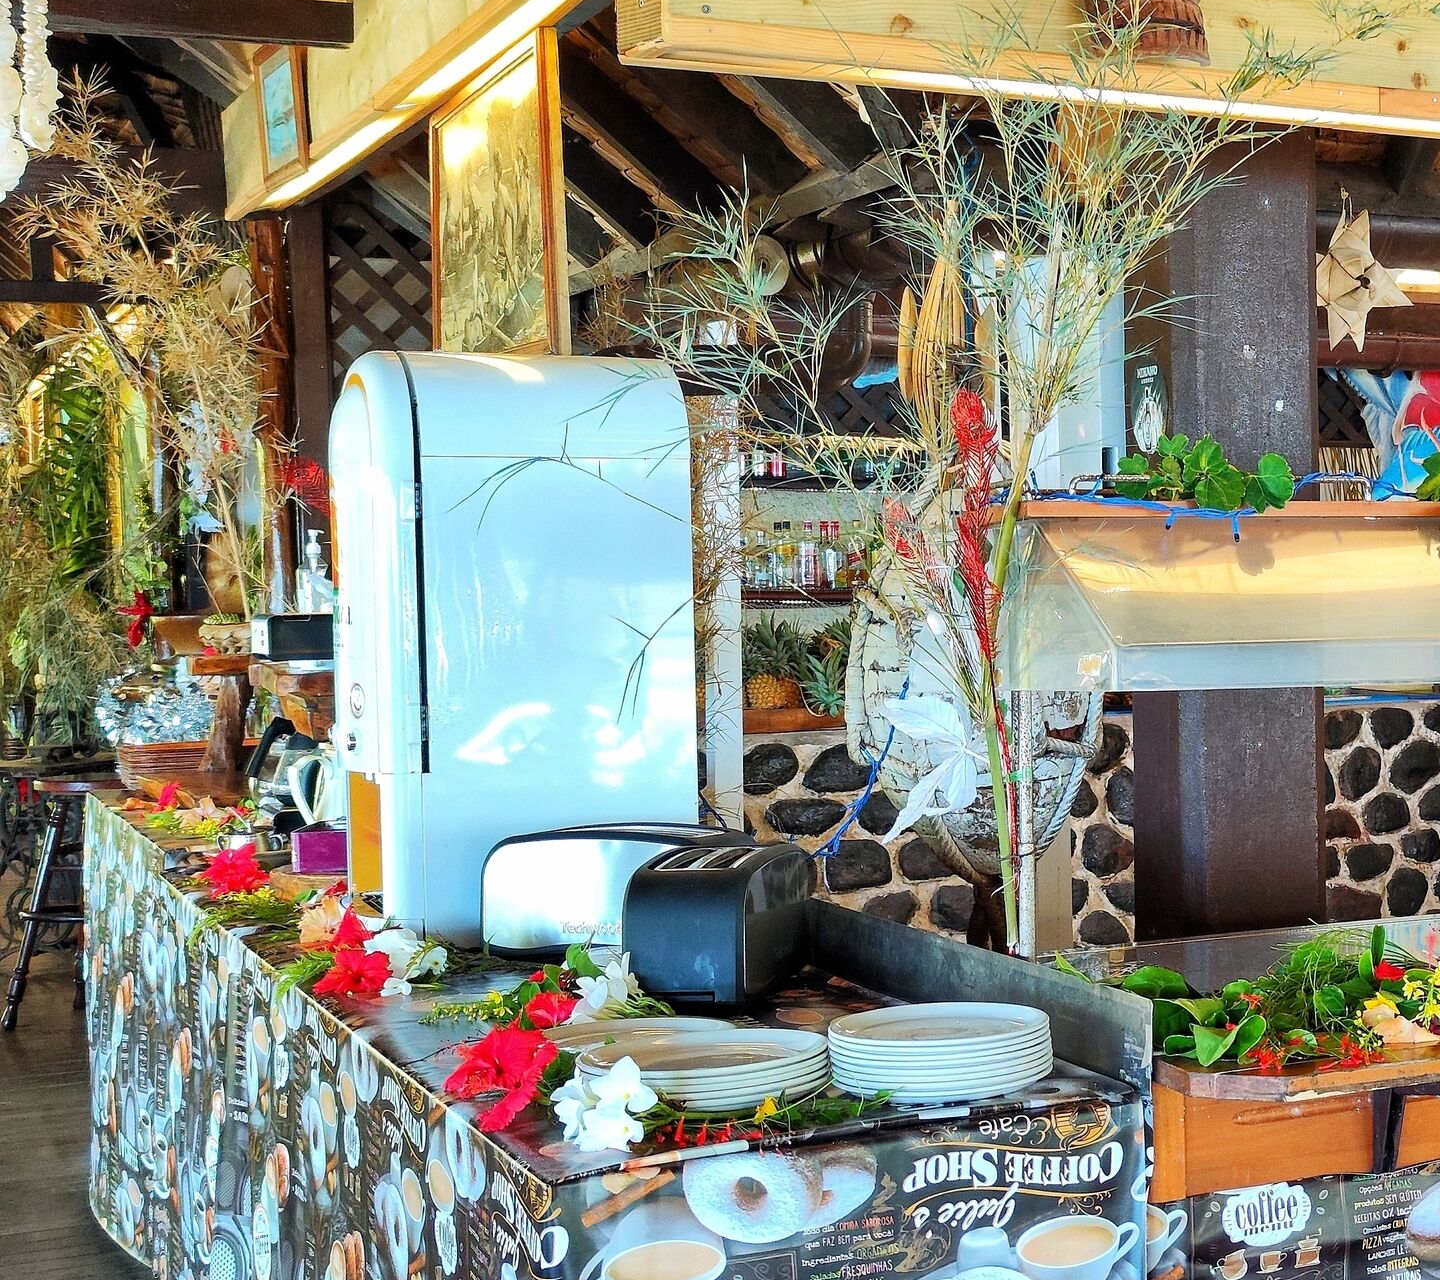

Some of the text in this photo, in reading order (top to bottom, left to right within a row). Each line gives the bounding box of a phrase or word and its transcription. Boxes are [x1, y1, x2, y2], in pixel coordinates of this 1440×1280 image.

[902, 1142, 1123, 1193] COFFEE SHOP
[1385, 1193, 1397, 1205] SEM
[1235, 1190, 1299, 1229] coffee
[1382, 1208, 1394, 1218] 0%
[1244, 1220, 1294, 1236] menu
[823, 1235, 835, 1246] FAZ
[838, 1234, 850, 1245] BEM
[1362, 1235, 1383, 1250] PIZZA
